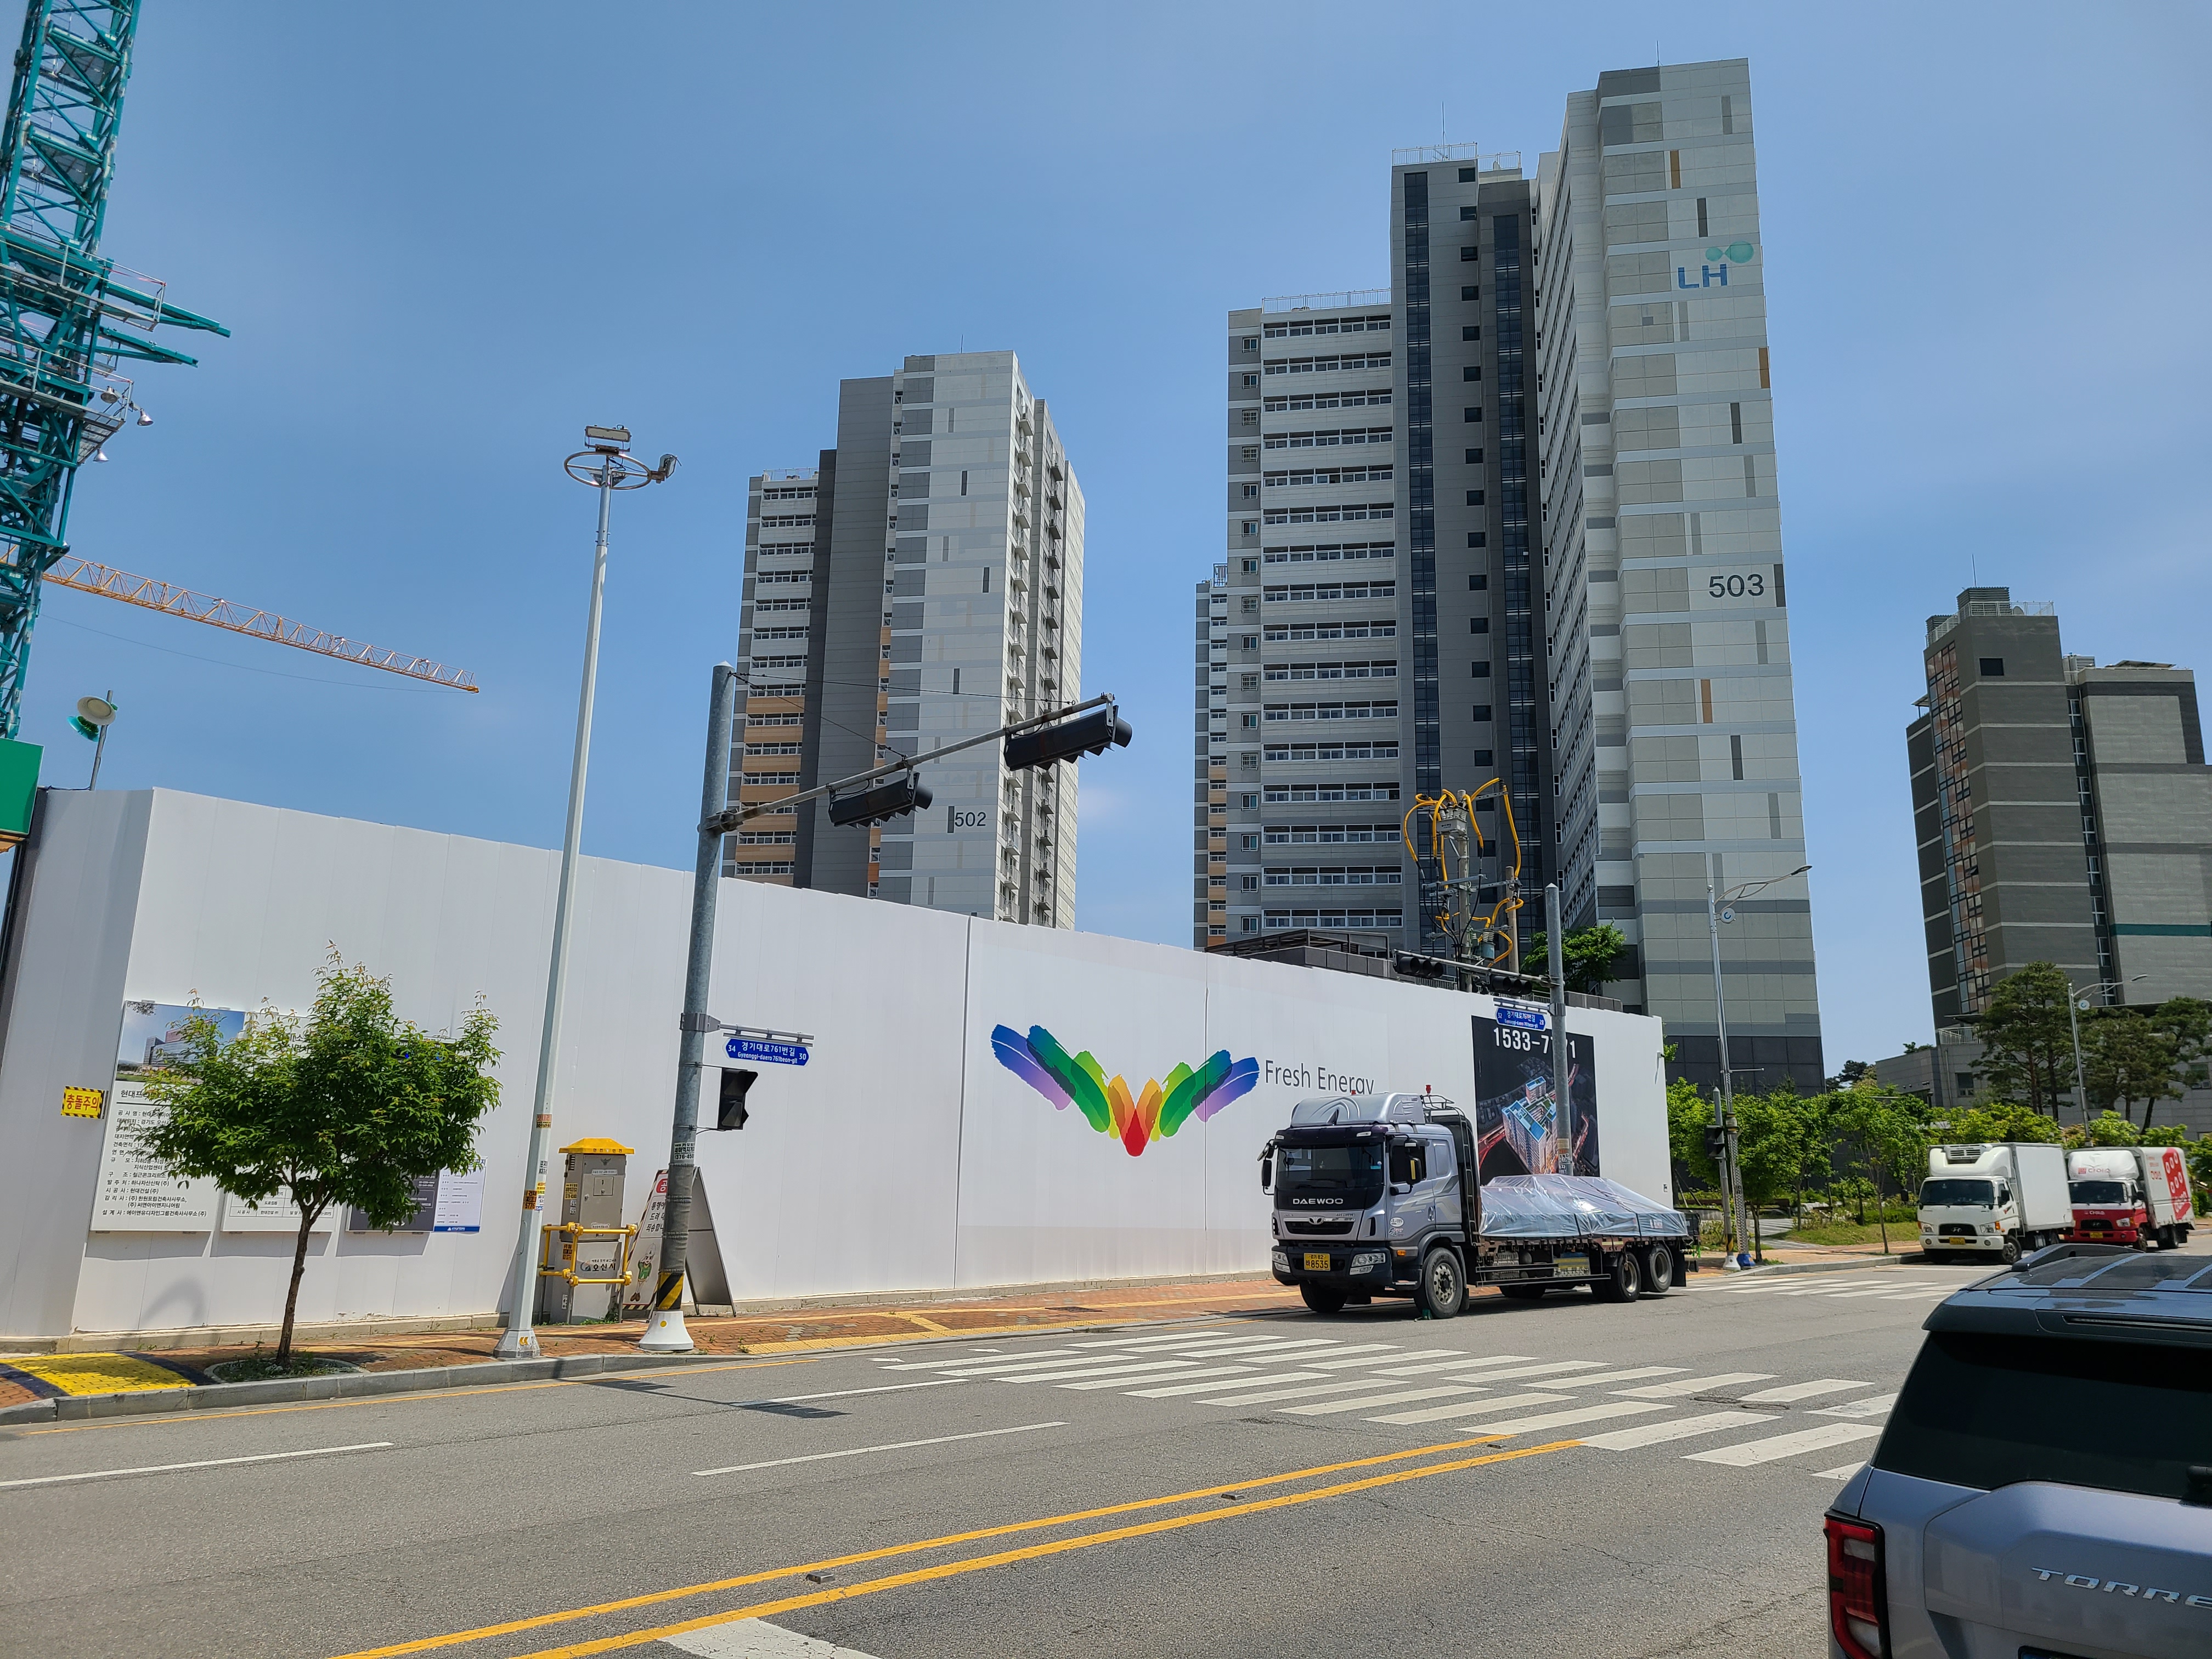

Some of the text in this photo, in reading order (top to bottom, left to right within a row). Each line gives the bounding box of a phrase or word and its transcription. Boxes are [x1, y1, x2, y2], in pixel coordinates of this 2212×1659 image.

[1677, 263, 1728, 289] LH
[1709, 574, 1764, 598] 503
[955, 811, 986, 827] 502
[741, 1042, 795, 1057] 경기대로761번길
[1493, 1027, 1576, 1058] 1533-71
[737, 1052, 798, 1064] Gyeonggi-daero 761beon-gil
[1265, 1059, 1311, 1088] Fresh
[66, 1093, 99, 1111] 충돌주의
[592, 1263, 616, 1272] 오산시
